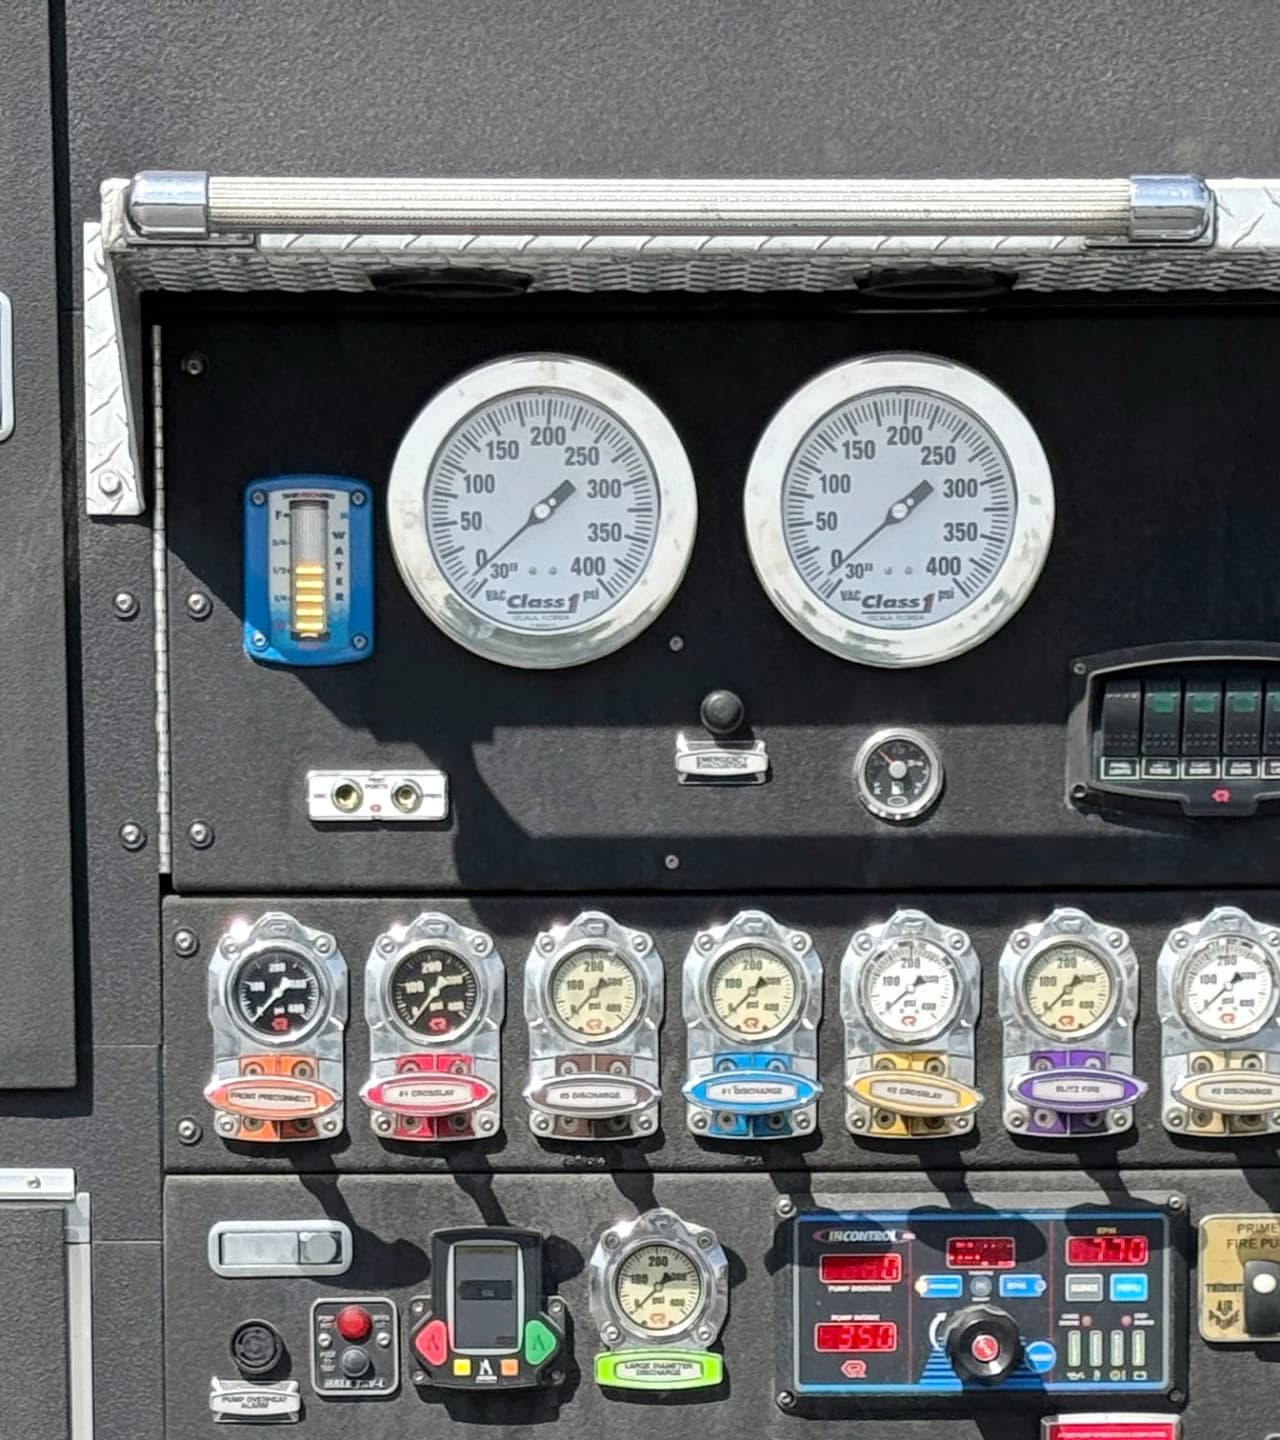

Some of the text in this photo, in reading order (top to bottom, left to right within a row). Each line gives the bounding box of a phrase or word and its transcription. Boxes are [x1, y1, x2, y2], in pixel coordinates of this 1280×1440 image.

[530, 426, 566, 446] 200
[887, 426, 922, 445] 200
[485, 440, 519, 460] 150
[842, 440, 875, 460] 150
[921, 446, 956, 465] 250
[564, 447, 600, 466] 250
[464, 474, 495, 493] 100
[587, 479, 621, 498] 300
[820, 474, 850, 493] 100
[943, 479, 978, 498] 300
[460, 511, 482, 530] 50
[816, 511, 837, 530] 50
[587, 523, 621, 542] 350
[943, 523, 977, 541] 350
[476, 549, 487, 568] 0
[831, 549, 842, 568] 0
[332, 531, 345, 601] WATER
[570, 556, 605, 576] 400
[926, 556, 961, 576] 400
[485, 590, 506, 602] VAC
[583, 590, 599, 603] psi
[840, 590, 861, 602] VAC
[938, 588, 954, 602] psi
[584, 960, 604, 973] 200
[743, 959, 762, 971] 200
[901, 956, 921, 968] 200
[1057, 956, 1077, 968] 200
[1217, 955, 1237, 966] 200
[422, 961, 442, 973] 200
[566, 979, 584, 990] 100
[724, 977, 742, 989] 100
[883, 975, 900, 987] 100
[1039, 975, 1057, 987] 100
[1200, 973, 1217, 985] 100
[405, 981, 424, 992] 100
[230, 1092, 257, 1100] FRONT
[572, 1091, 621, 1099] DISCHARGE
[733, 1086, 783, 1095] DISCHARGE
[1224, 1087, 1273, 1096] DISCHARGE
[828, 1230, 897, 1242] INCONTROL
[1227, 1238, 1257, 1249] FIRE
[648, 1257, 668, 1267] 200
[631, 1274, 648, 1284] 100
[828, 1285, 850, 1293] PUMP
